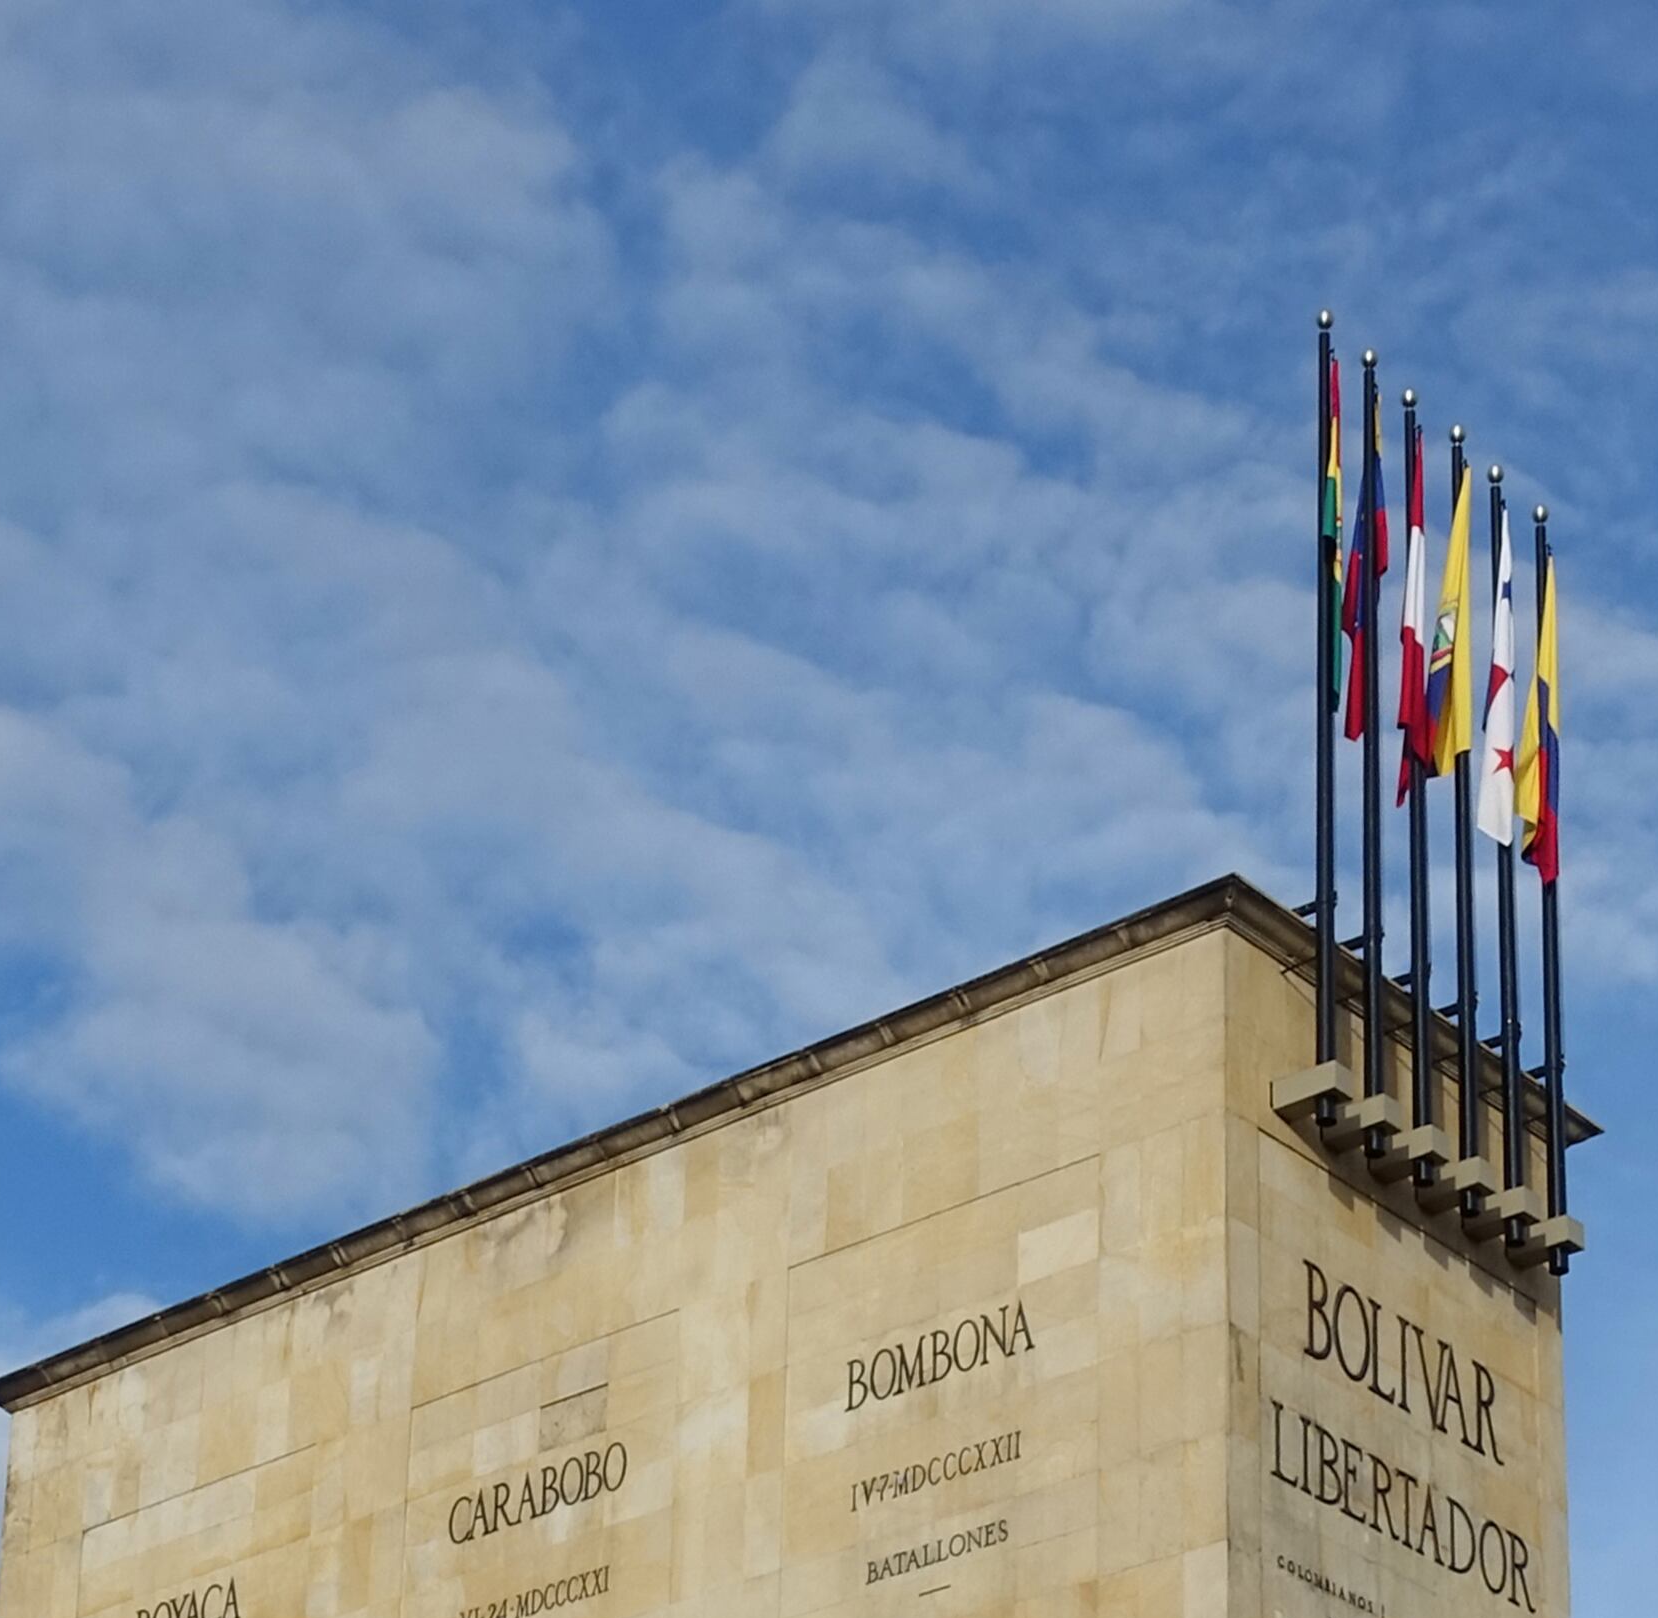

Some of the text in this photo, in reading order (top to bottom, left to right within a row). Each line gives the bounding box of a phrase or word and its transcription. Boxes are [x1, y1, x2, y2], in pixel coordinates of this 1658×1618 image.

[844, 1300, 1035, 1413] BOMBONA
[1302, 1259, 1505, 1467] BOLIVAR
[448, 1442, 627, 1544] CARABOBO
[1269, 1397, 1536, 1613] LIBERTADOR
[865, 1519, 1009, 1586] BATALLONES
